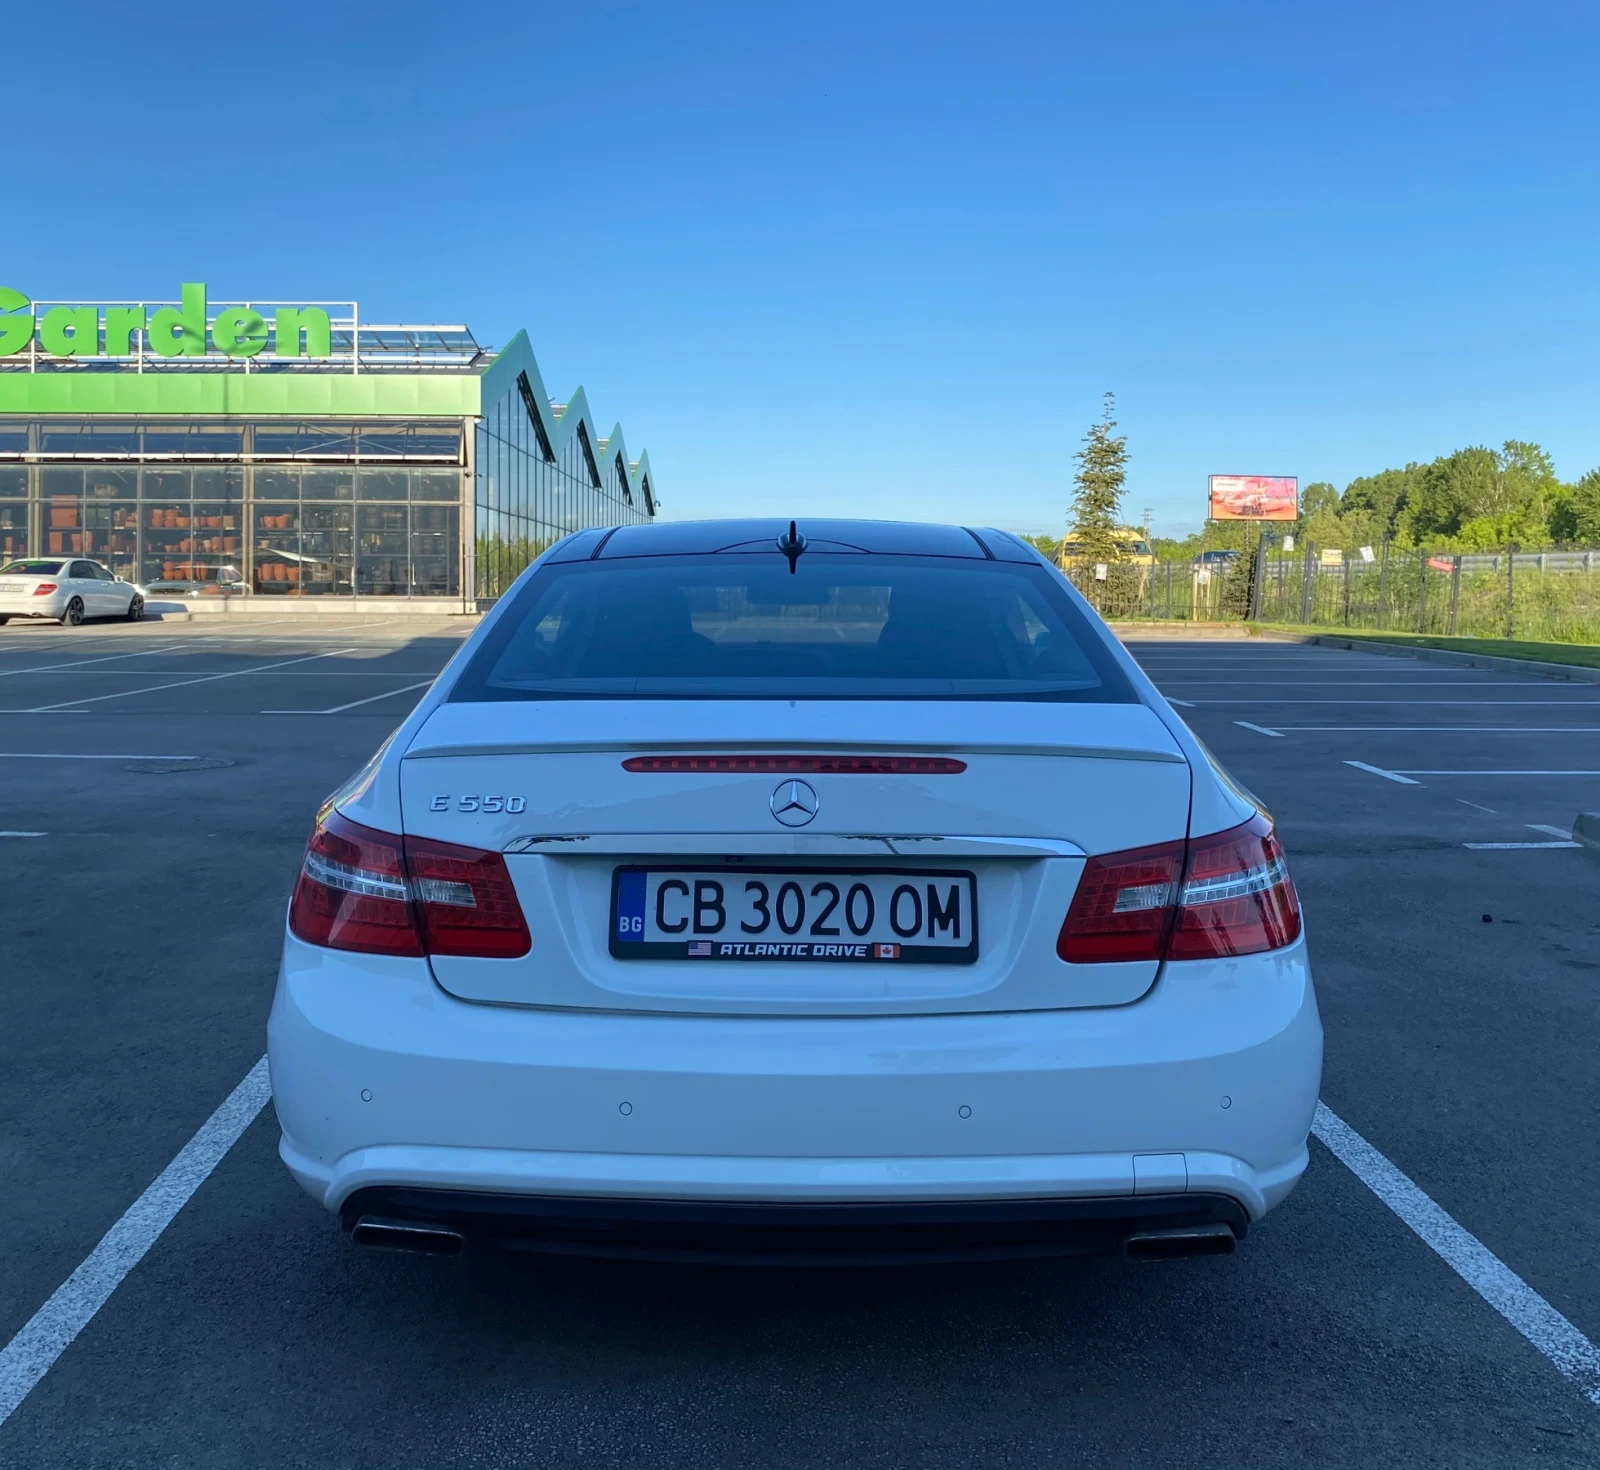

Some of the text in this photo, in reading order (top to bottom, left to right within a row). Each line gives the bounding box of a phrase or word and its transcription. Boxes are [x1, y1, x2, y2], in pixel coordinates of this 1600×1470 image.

[430, 794, 527, 814] E 550
[655, 879, 961, 939] CB 3020 OM
[619, 916, 642, 933] BG
[720, 944, 867, 957] ATLANTIC DRIVE
